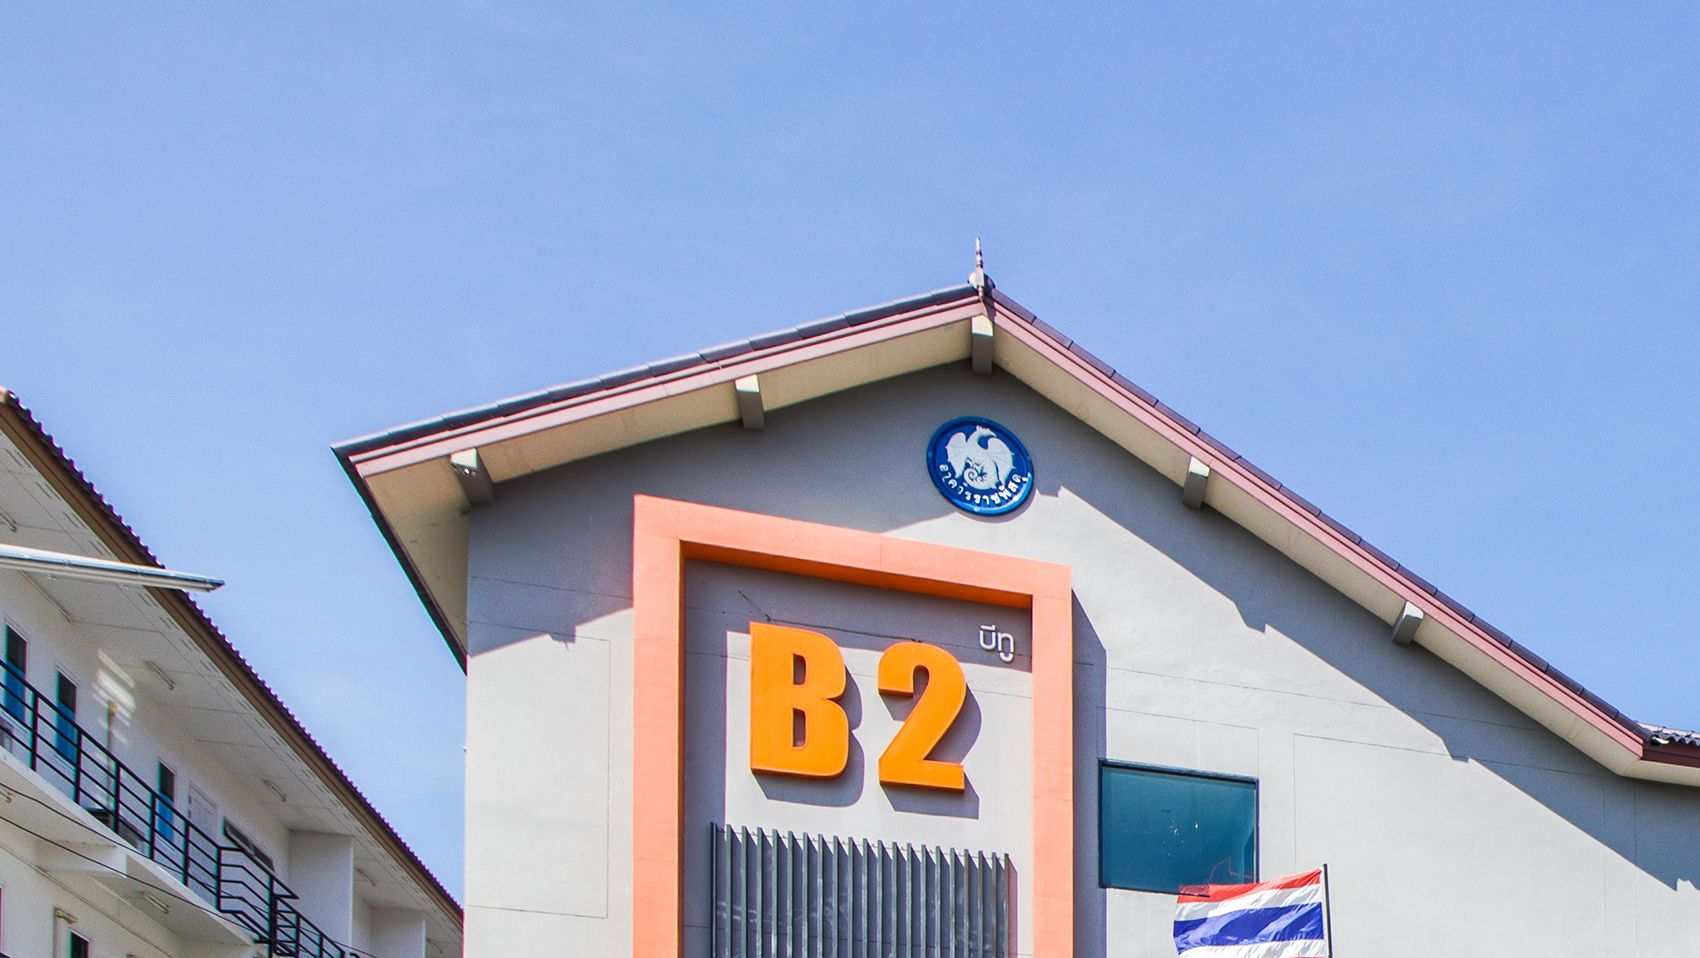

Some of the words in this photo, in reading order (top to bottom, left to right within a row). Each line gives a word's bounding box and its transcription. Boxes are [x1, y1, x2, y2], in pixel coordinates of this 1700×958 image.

[939, 464, 1029, 505] อาคารราชพัสดุ
[979, 624, 1014, 662] บีทู
[749, 621, 967, 791] B2
